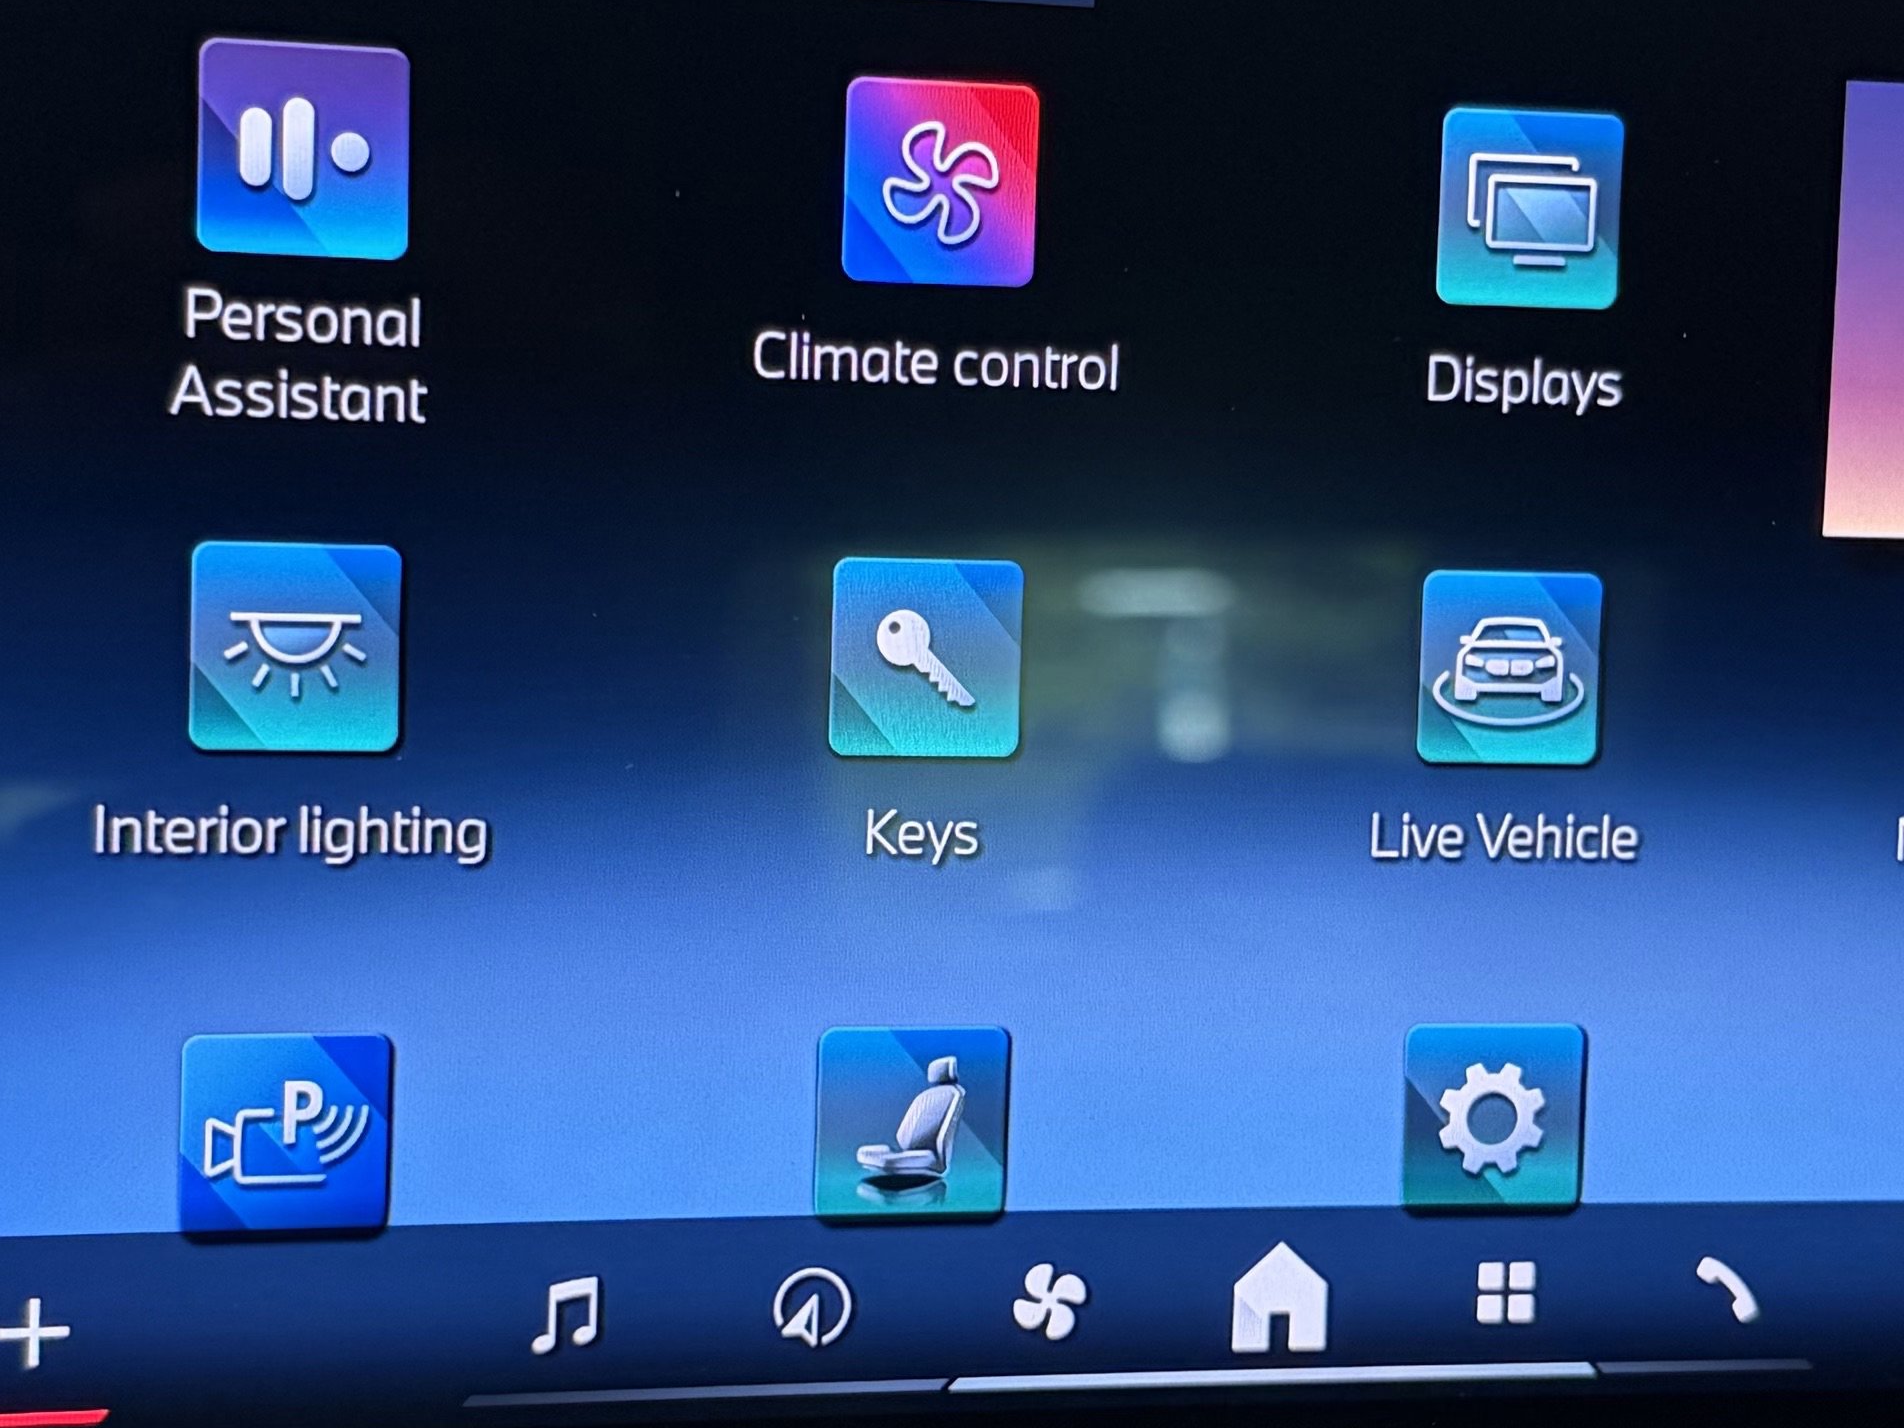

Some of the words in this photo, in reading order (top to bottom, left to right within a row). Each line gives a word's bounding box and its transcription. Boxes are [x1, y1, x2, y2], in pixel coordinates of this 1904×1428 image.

[184, 285, 422, 349] Personal
[752, 328, 940, 386] Climate
[952, 342, 1120, 393] control
[1426, 352, 1624, 417] Displays
[167, 362, 429, 425] Assistant
[93, 803, 288, 855] Interior
[298, 803, 488, 866] lighting
[865, 807, 979, 866] Keys
[1369, 810, 1465, 859] Live
[1475, 811, 1639, 861] Vehicle
[281, 1078, 325, 1145] P
